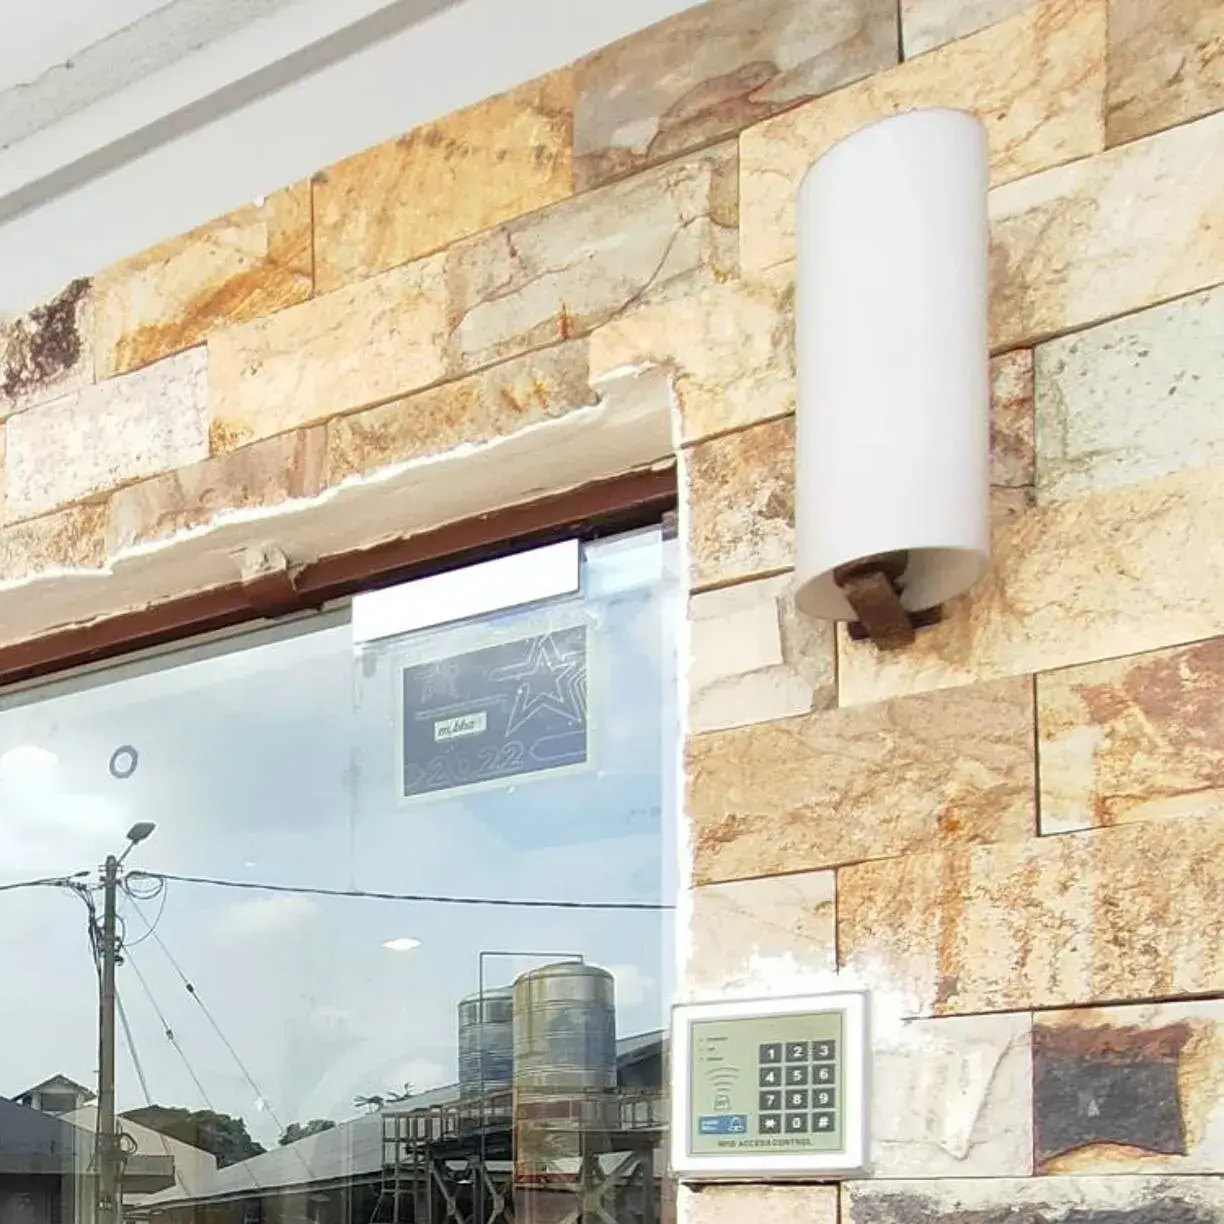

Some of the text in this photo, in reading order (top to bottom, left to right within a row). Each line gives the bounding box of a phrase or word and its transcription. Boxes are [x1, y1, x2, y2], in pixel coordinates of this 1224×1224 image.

[767, 1048, 775, 1059] 1
[794, 1045, 803, 1057] 2
[819, 1044, 829, 1056] 3
[765, 1071, 775, 1083] 4
[793, 1070, 802, 1082] 5
[819, 1069, 829, 1080] 6
[767, 1095, 775, 1106] 7
[792, 1093, 802, 1105] 8
[819, 1092, 829, 1104] 9
[792, 1117, 802, 1129] 0
